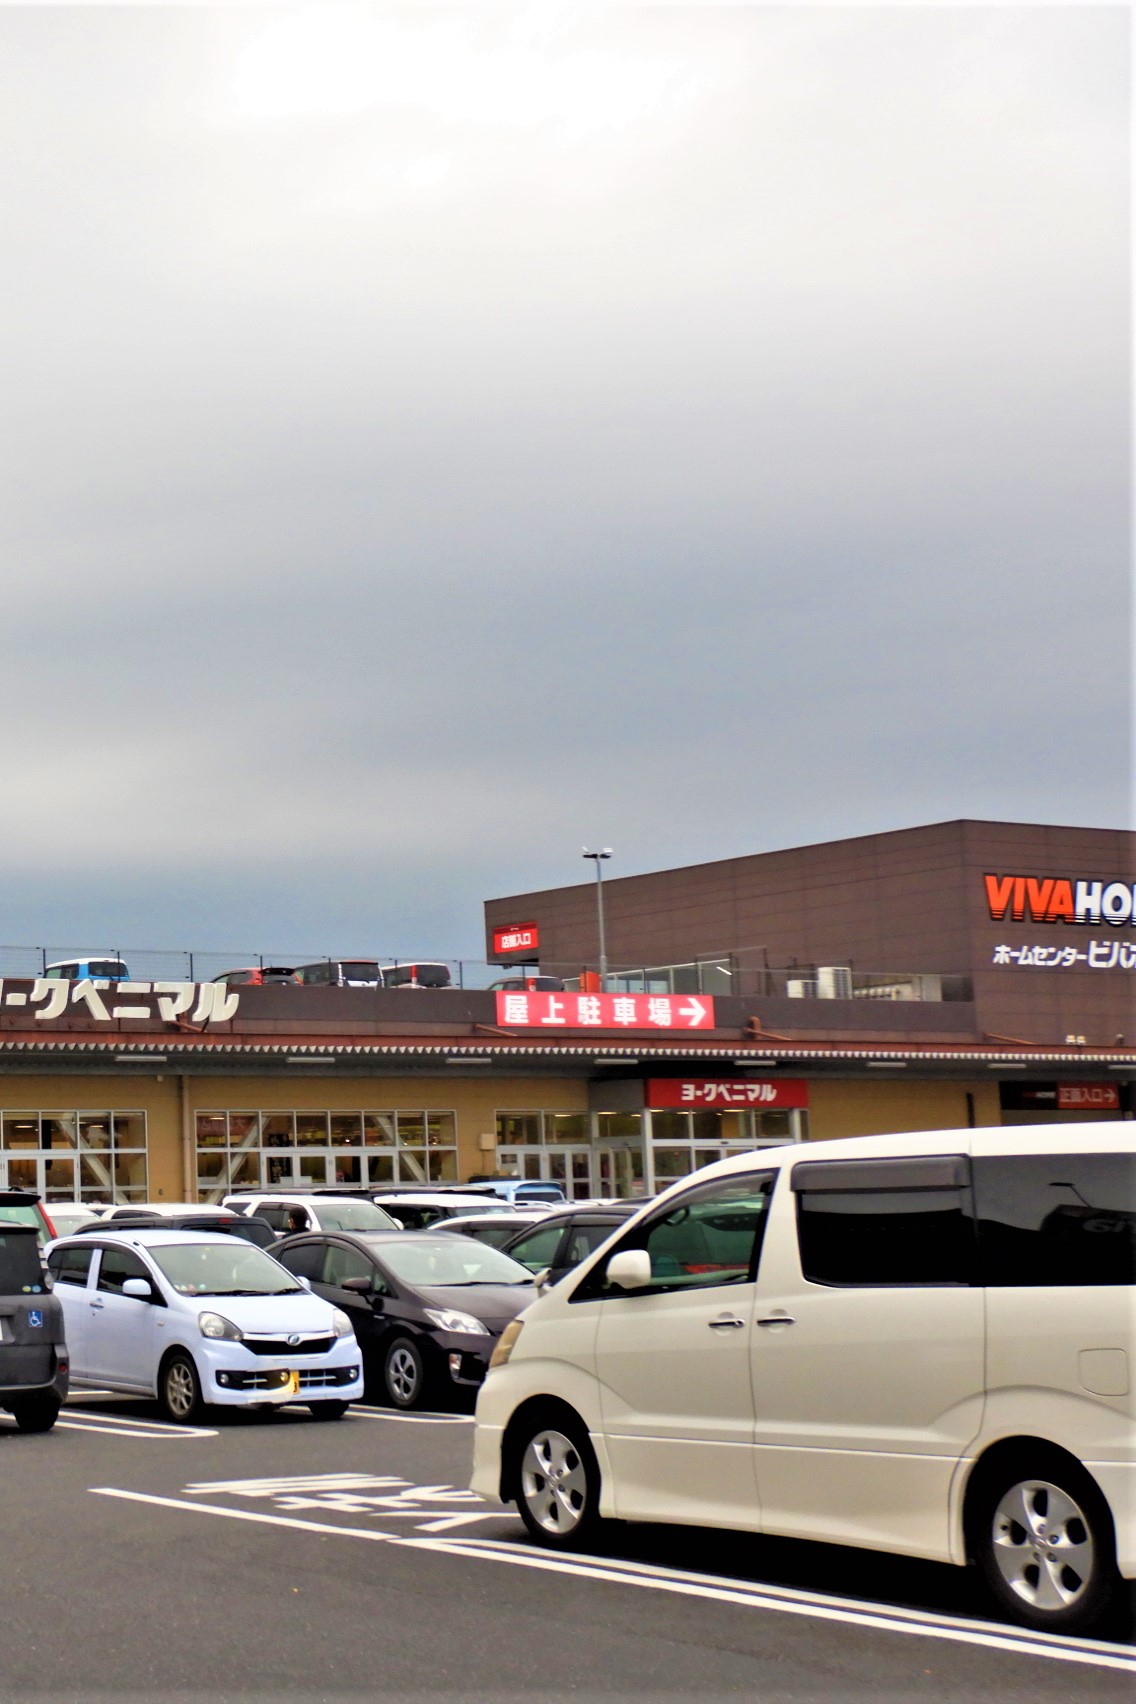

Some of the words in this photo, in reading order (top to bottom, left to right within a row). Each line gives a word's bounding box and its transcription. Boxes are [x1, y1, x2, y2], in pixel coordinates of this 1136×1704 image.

[984, 873, 1136, 927] VIVAHO
[504, 995, 672, 1027] 屋上駐車場
[680, 1083, 777, 1102] ヨークベニマル
